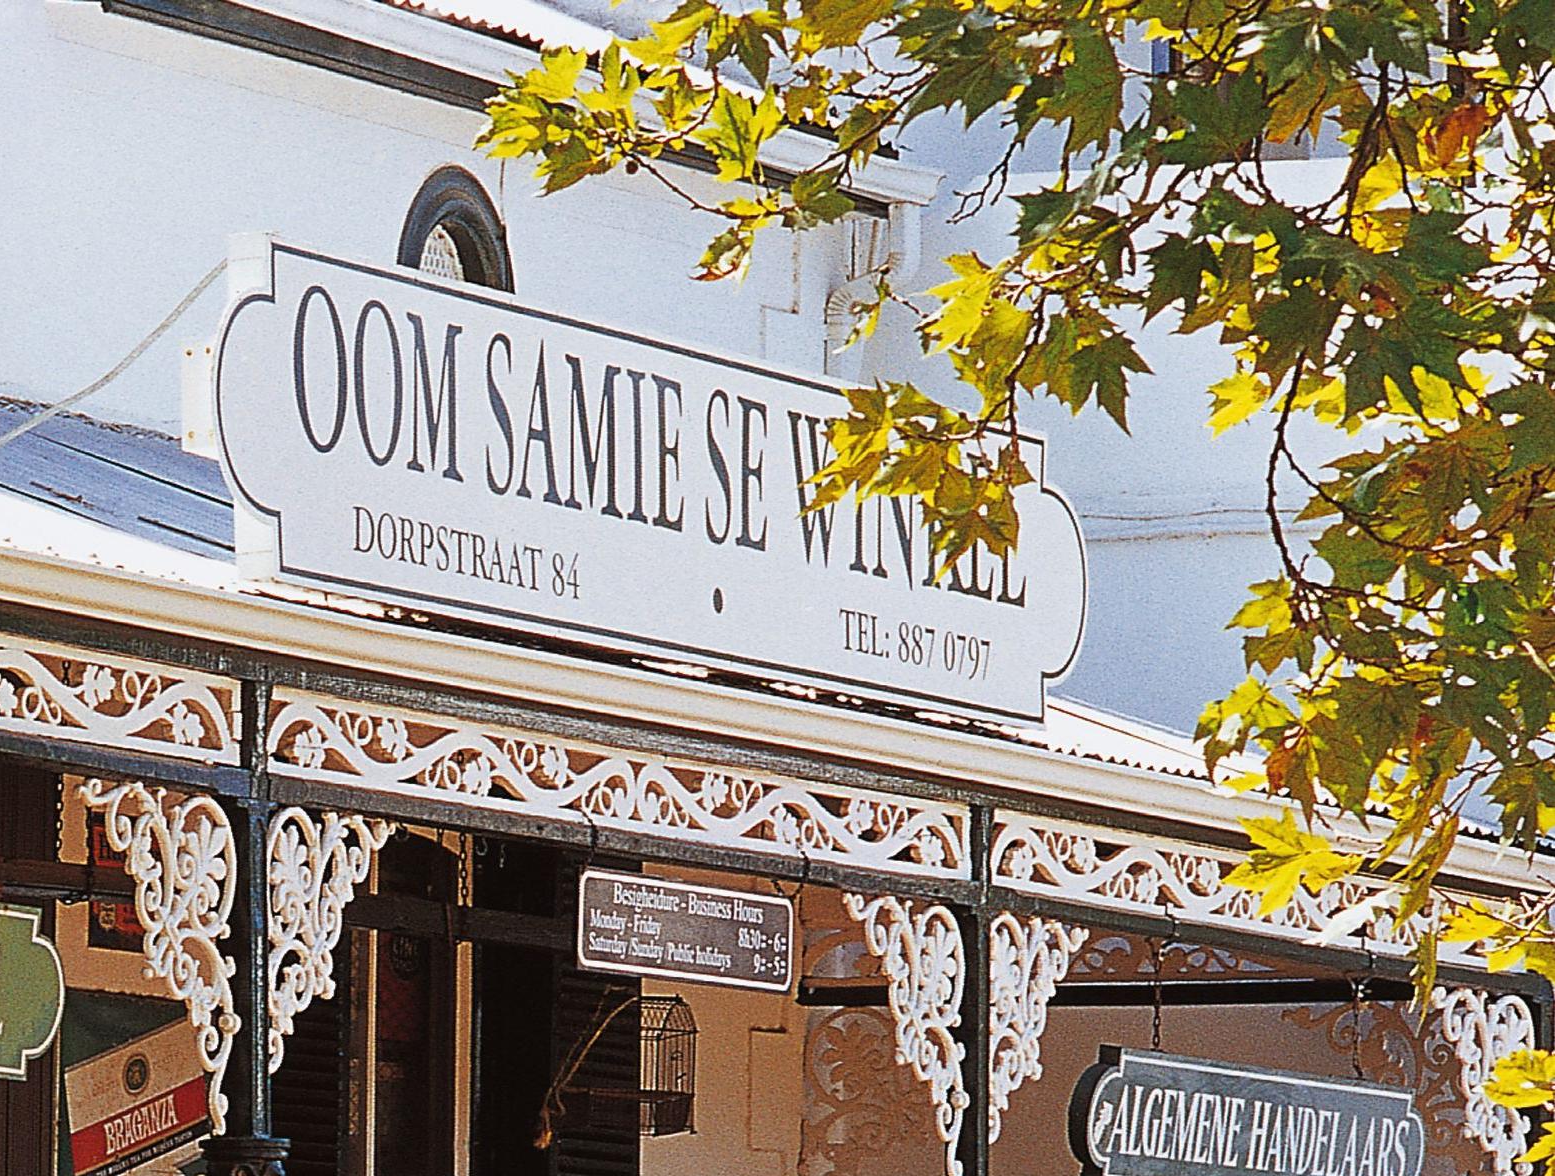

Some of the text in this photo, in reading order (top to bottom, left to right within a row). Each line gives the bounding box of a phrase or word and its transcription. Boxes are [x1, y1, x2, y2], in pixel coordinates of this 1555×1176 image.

[294, 285, 463, 483] OOM
[486, 333, 684, 532] SAMIE
[705, 389, 768, 551] SE
[352, 505, 580, 600] DORPSTRAAT 84
[840, 609, 991, 680] TEL: 887 0797
[590, 909, 626, 935] Monday
[634, 914, 661, 939] Friday
[613, 882, 679, 913] Besigheidure
[688, 893, 731, 920] Business
[734, 899, 763, 924] Hours
[589, 932, 628, 959] Saturday
[696, 945, 731, 974] holidays
[103, 1095, 179, 1156] BRAGANZA
[1107, 1084, 1245, 1167] ALGEMENE
